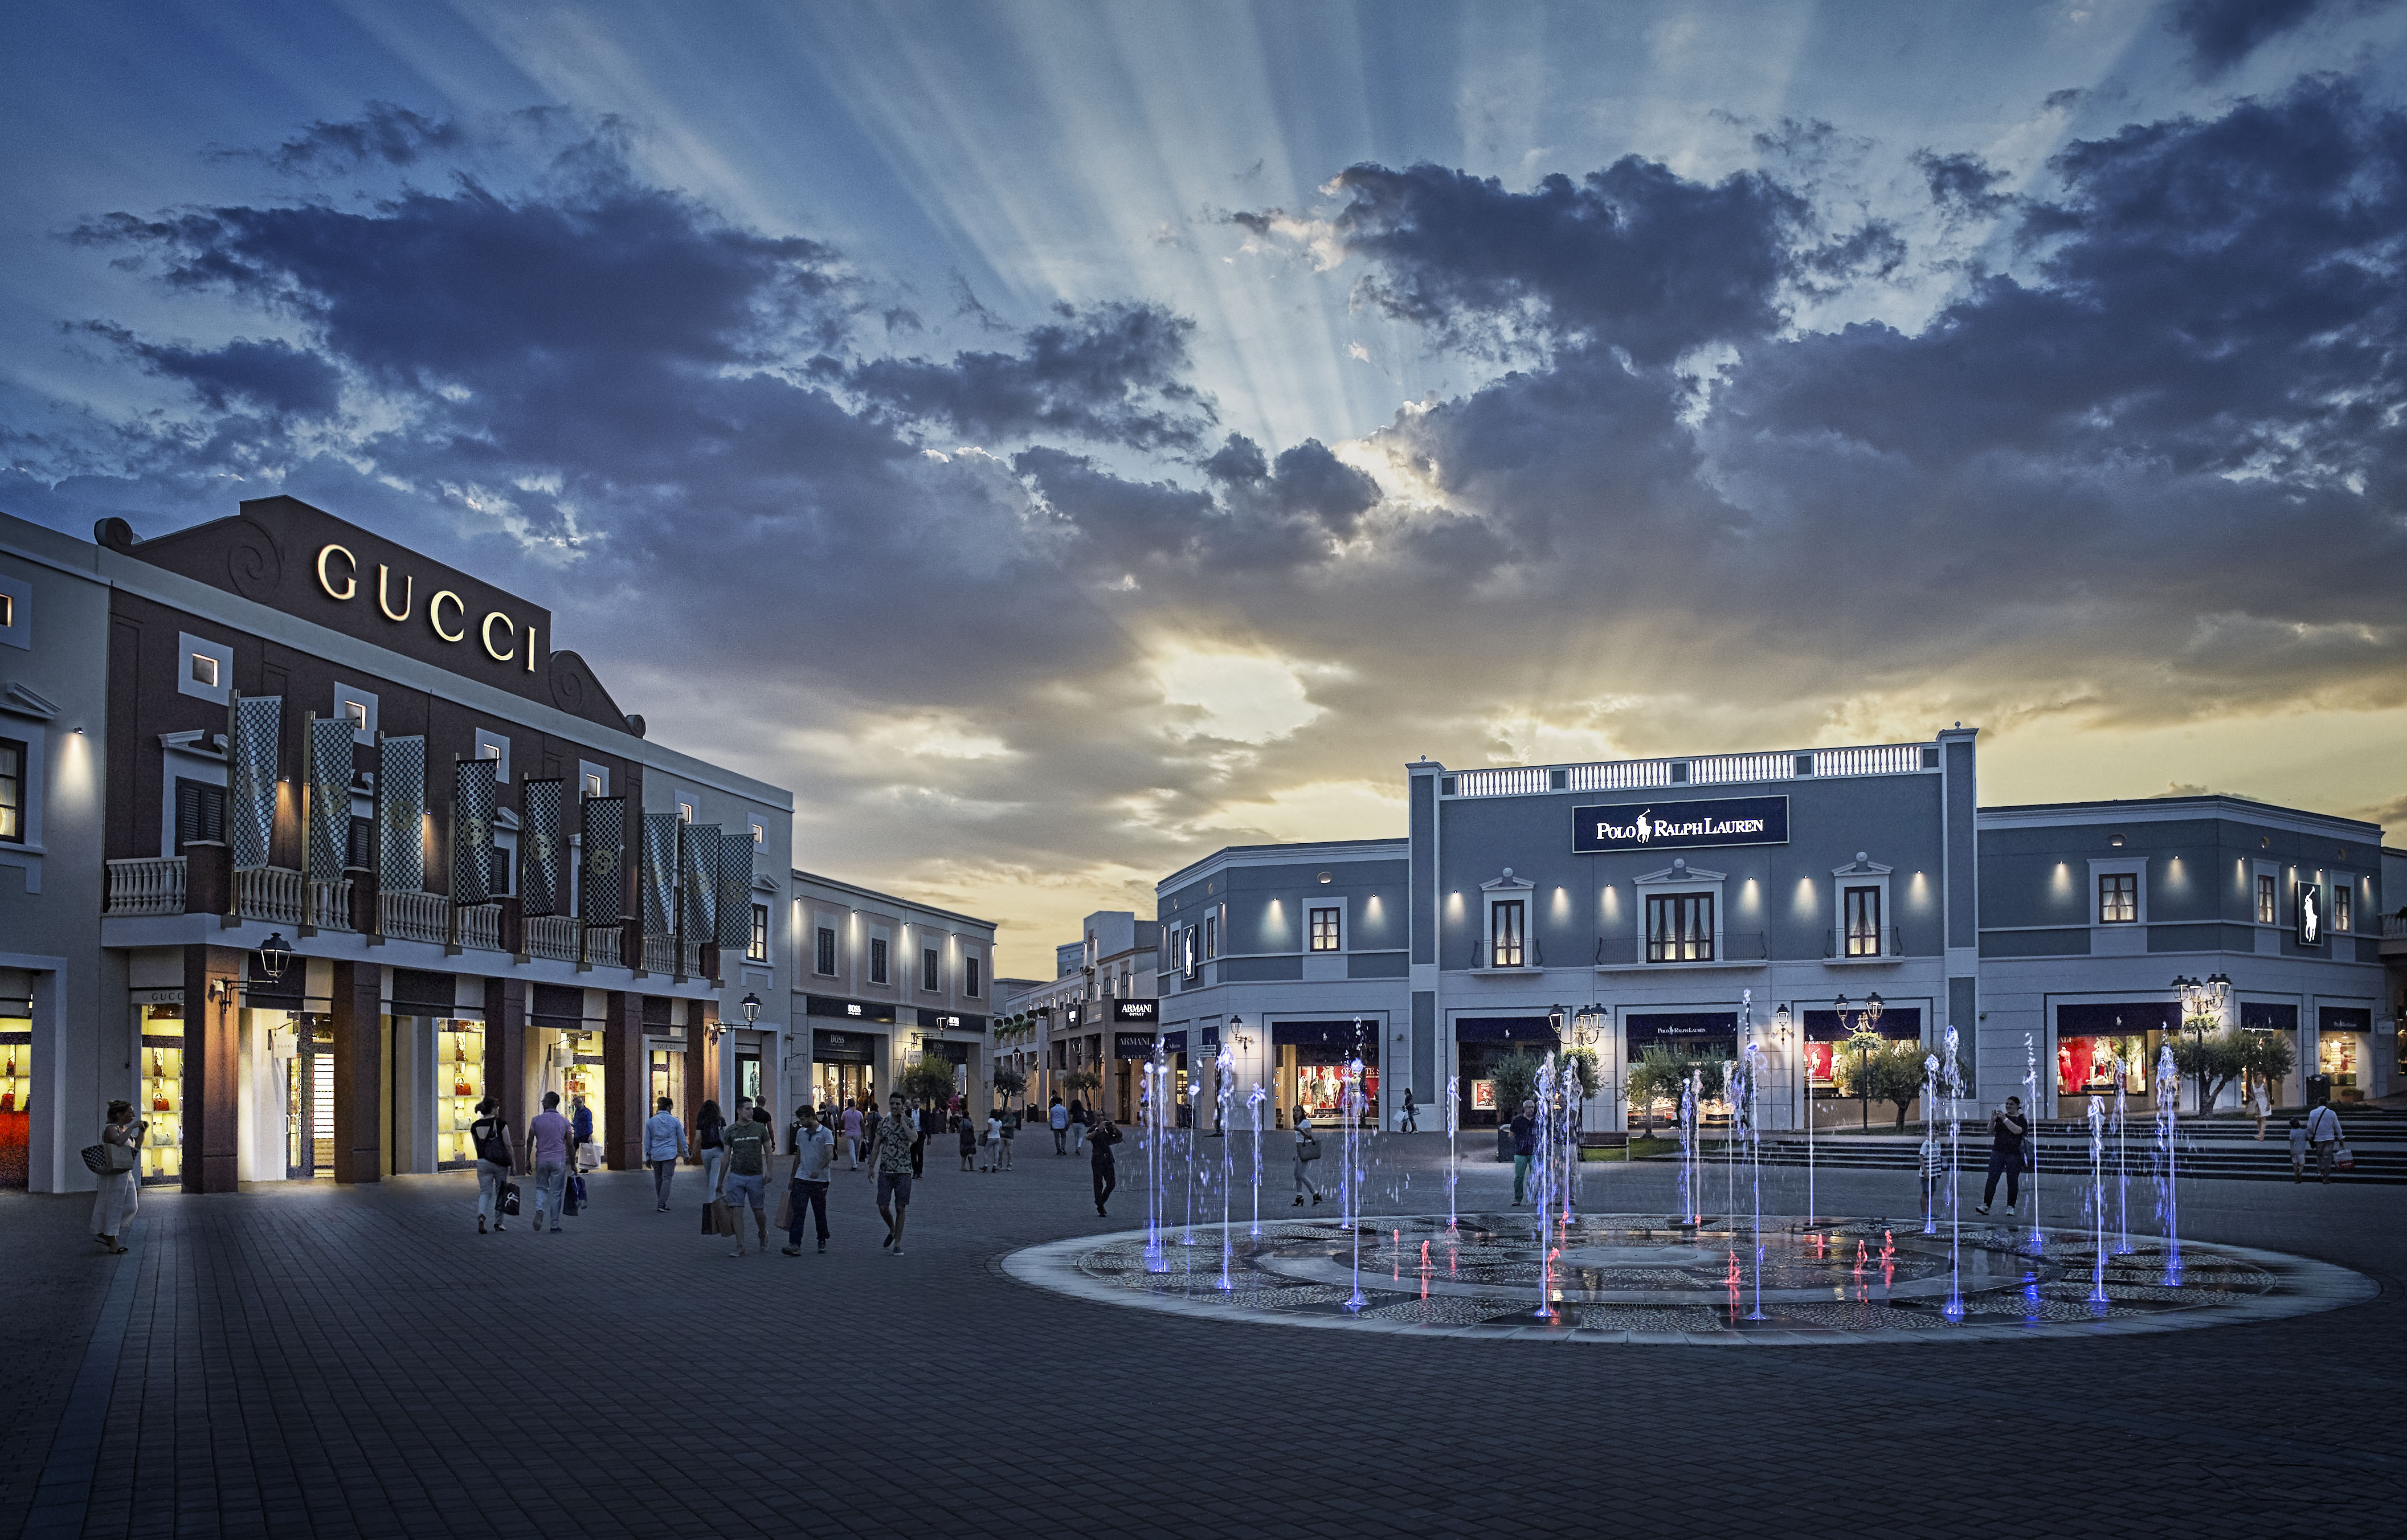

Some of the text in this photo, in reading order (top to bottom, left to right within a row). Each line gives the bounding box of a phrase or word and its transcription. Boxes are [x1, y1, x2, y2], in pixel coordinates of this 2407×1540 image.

[317, 544, 536, 672] GUCCI
[1596, 817, 1764, 839] POLO RALPH LAUREN
[152, 992, 184, 1001] GUCC
[848, 1004, 861, 1013] BOSS
[1121, 1004, 1152, 1013] ARMANI
[831, 1035, 844, 1044] BOSS
